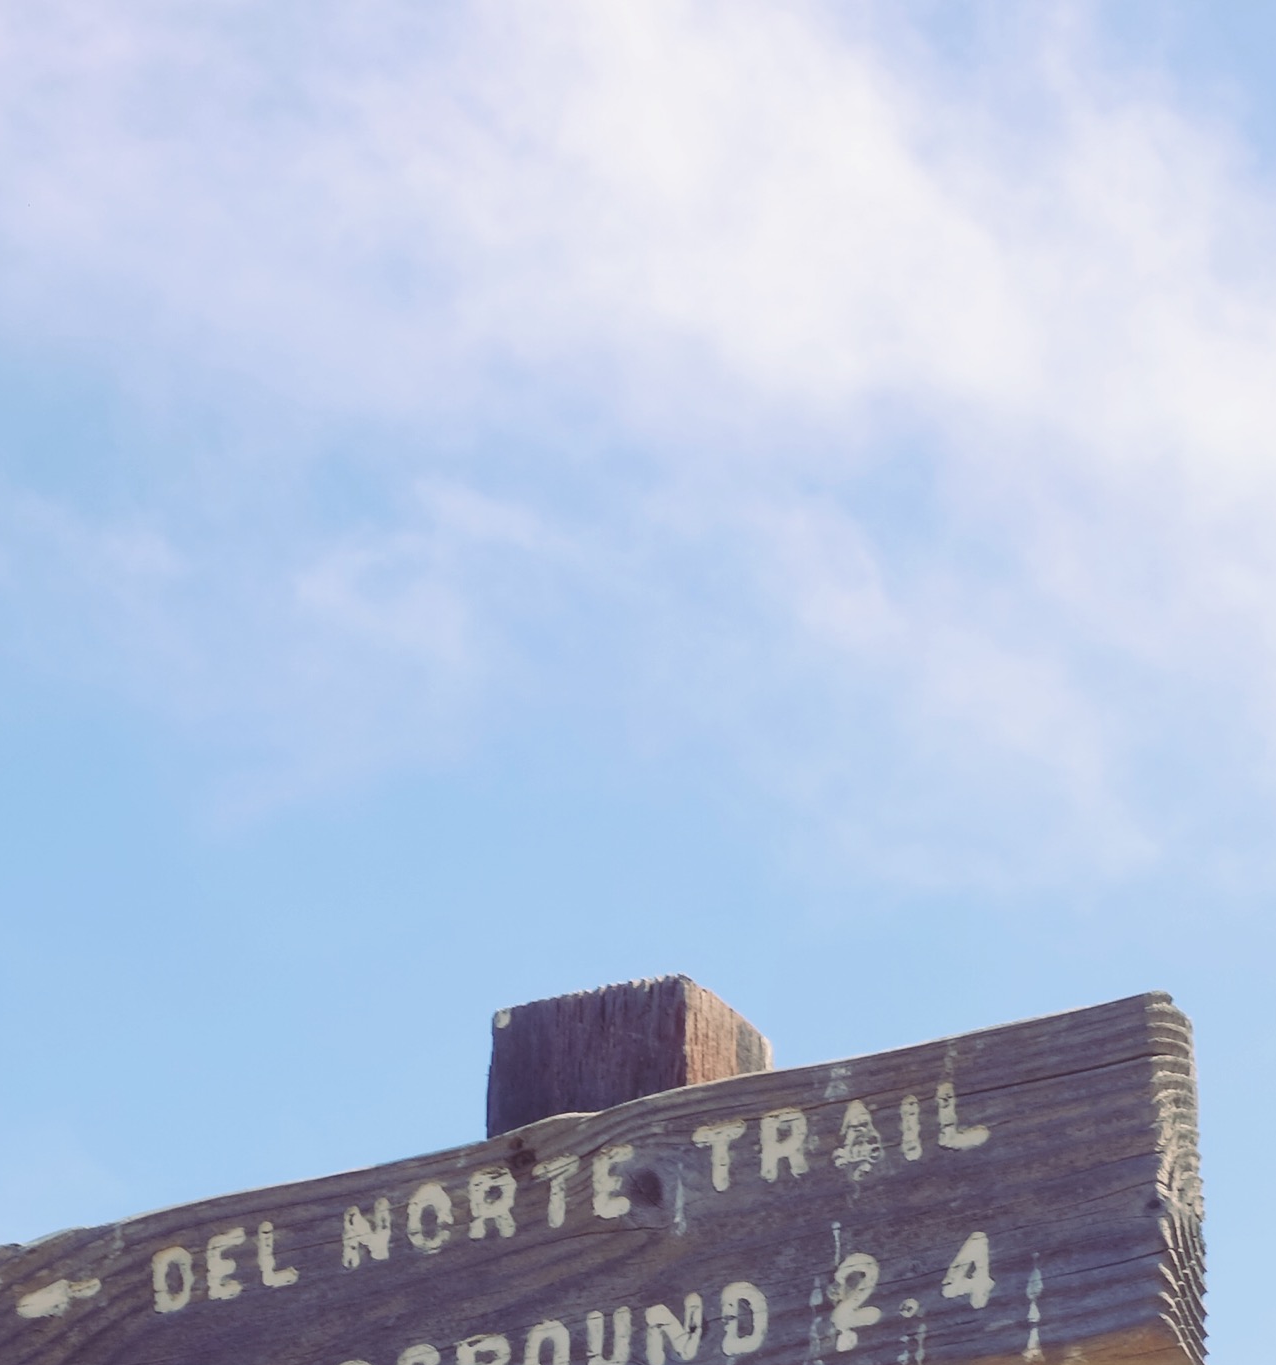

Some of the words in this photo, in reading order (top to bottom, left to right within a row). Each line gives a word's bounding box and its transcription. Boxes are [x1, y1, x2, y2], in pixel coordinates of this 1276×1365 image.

[152, 1220, 299, 1314] DEL
[341, 1144, 636, 1270] NORTE
[692, 1081, 990, 1194] TRAIL
